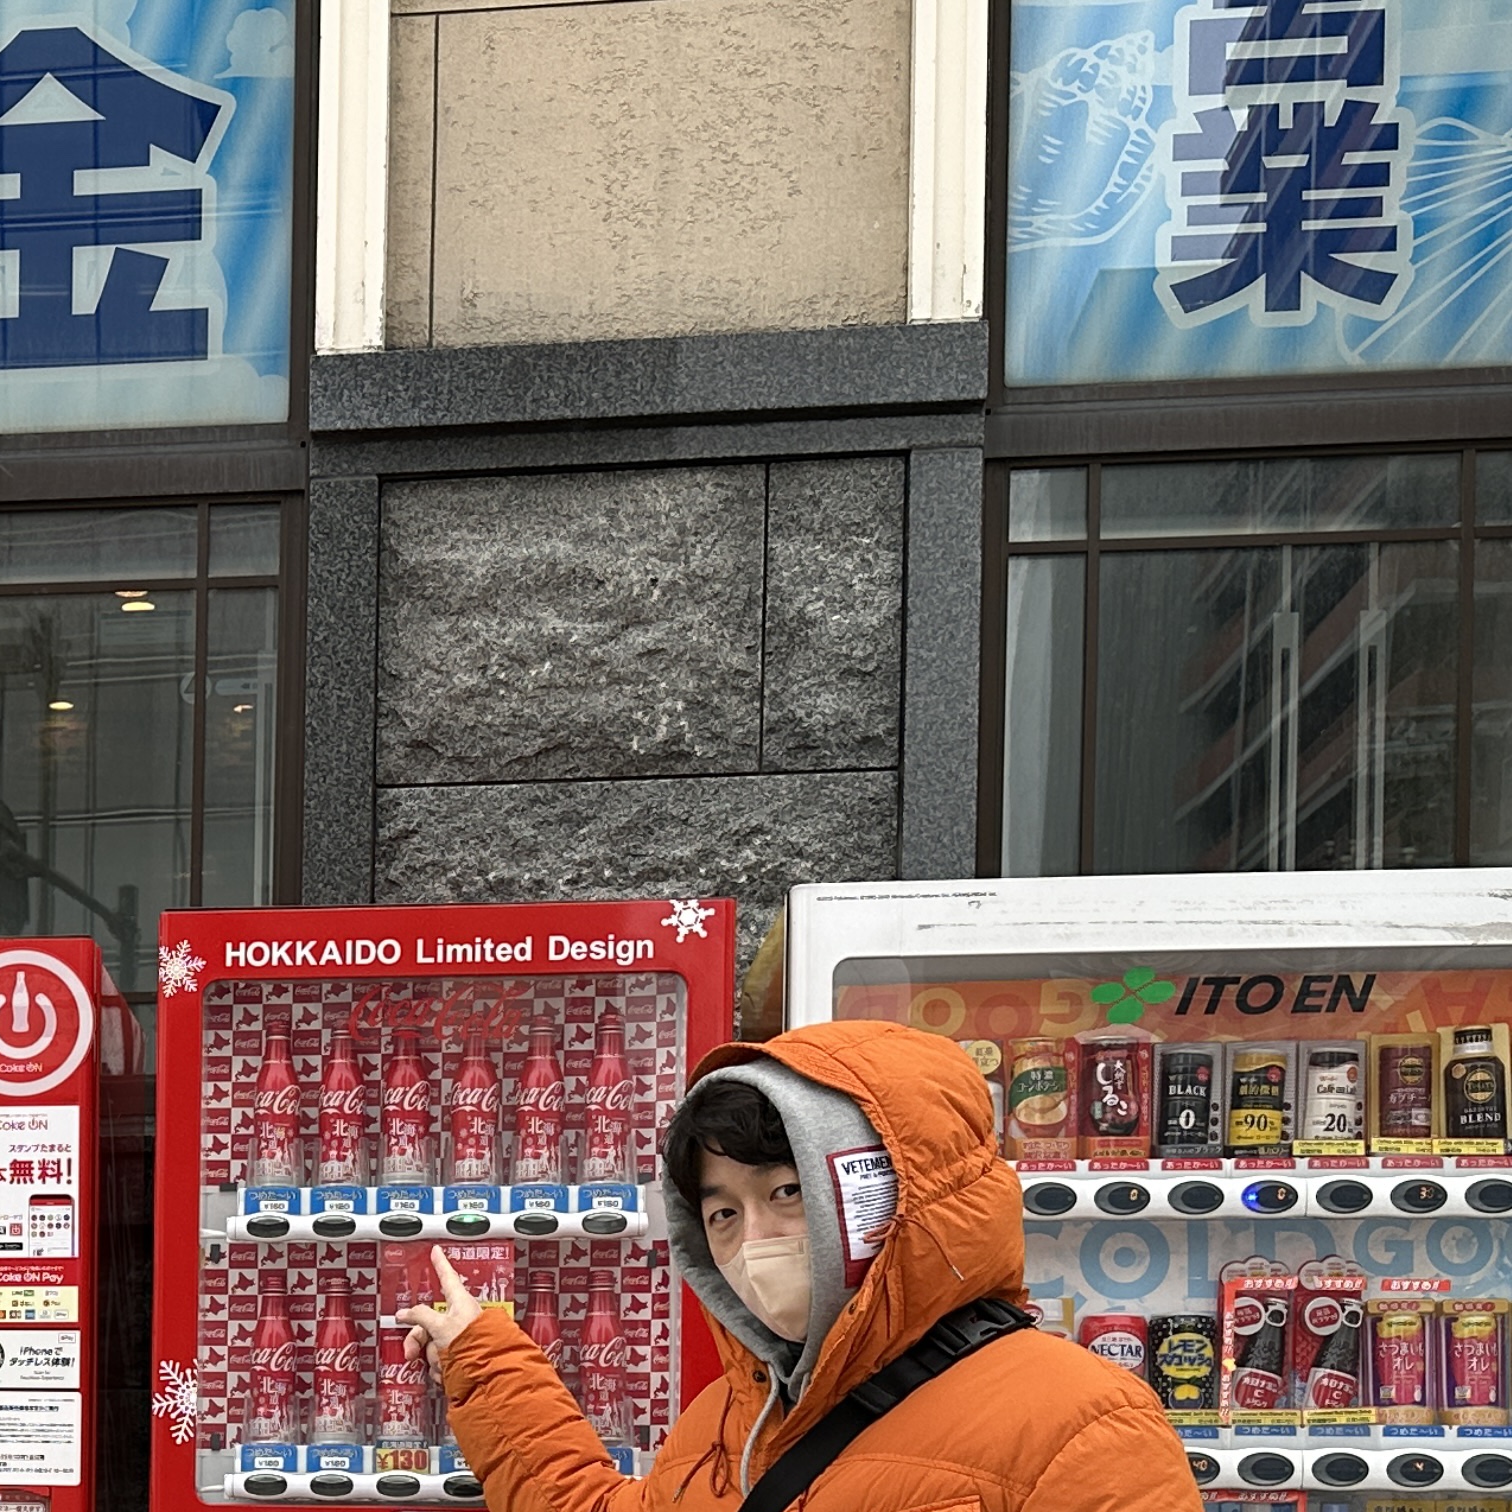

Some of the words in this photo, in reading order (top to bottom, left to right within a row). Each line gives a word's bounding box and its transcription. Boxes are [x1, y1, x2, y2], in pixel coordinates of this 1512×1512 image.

[224, 940, 402, 967] HOKKAIDO
[416, 937, 534, 965] Limited
[547, 935, 656, 966] Design
[1173, 974, 1287, 1018] ITO
[1290, 972, 1376, 1015] EN
[1096, 1062, 1128, 1117] しるこ
[1168, 1085, 1207, 1097] BLACK
[28, 1117, 49, 1131] ON
[1178, 1108, 1196, 1130] 0
[1244, 1114, 1268, 1133] 90
[1323, 1112, 1347, 1133] 20
[1460, 1112, 1502, 1125] BLEND
[8, 1143, 72, 1153] スタンプたまると
[23, 1270, 41, 1283] ON
[41, 1272, 64, 1285] Pay
[1390, 1280, 1440, 1291] おすすめ!!
[18, 1346, 65, 1357] iPhoneで
[1091, 1344, 1143, 1358] NECTAR
[1168, 1338, 1208, 1351] レモン
[8, 1356, 76, 1369] タッチレス体験!
[1158, 1353, 1212, 1367] スカッシュ
[1392, 1356, 1415, 1371] オレ
[1468, 1356, 1490, 1372] オレ
[376, 1450, 428, 1471] ¥130
